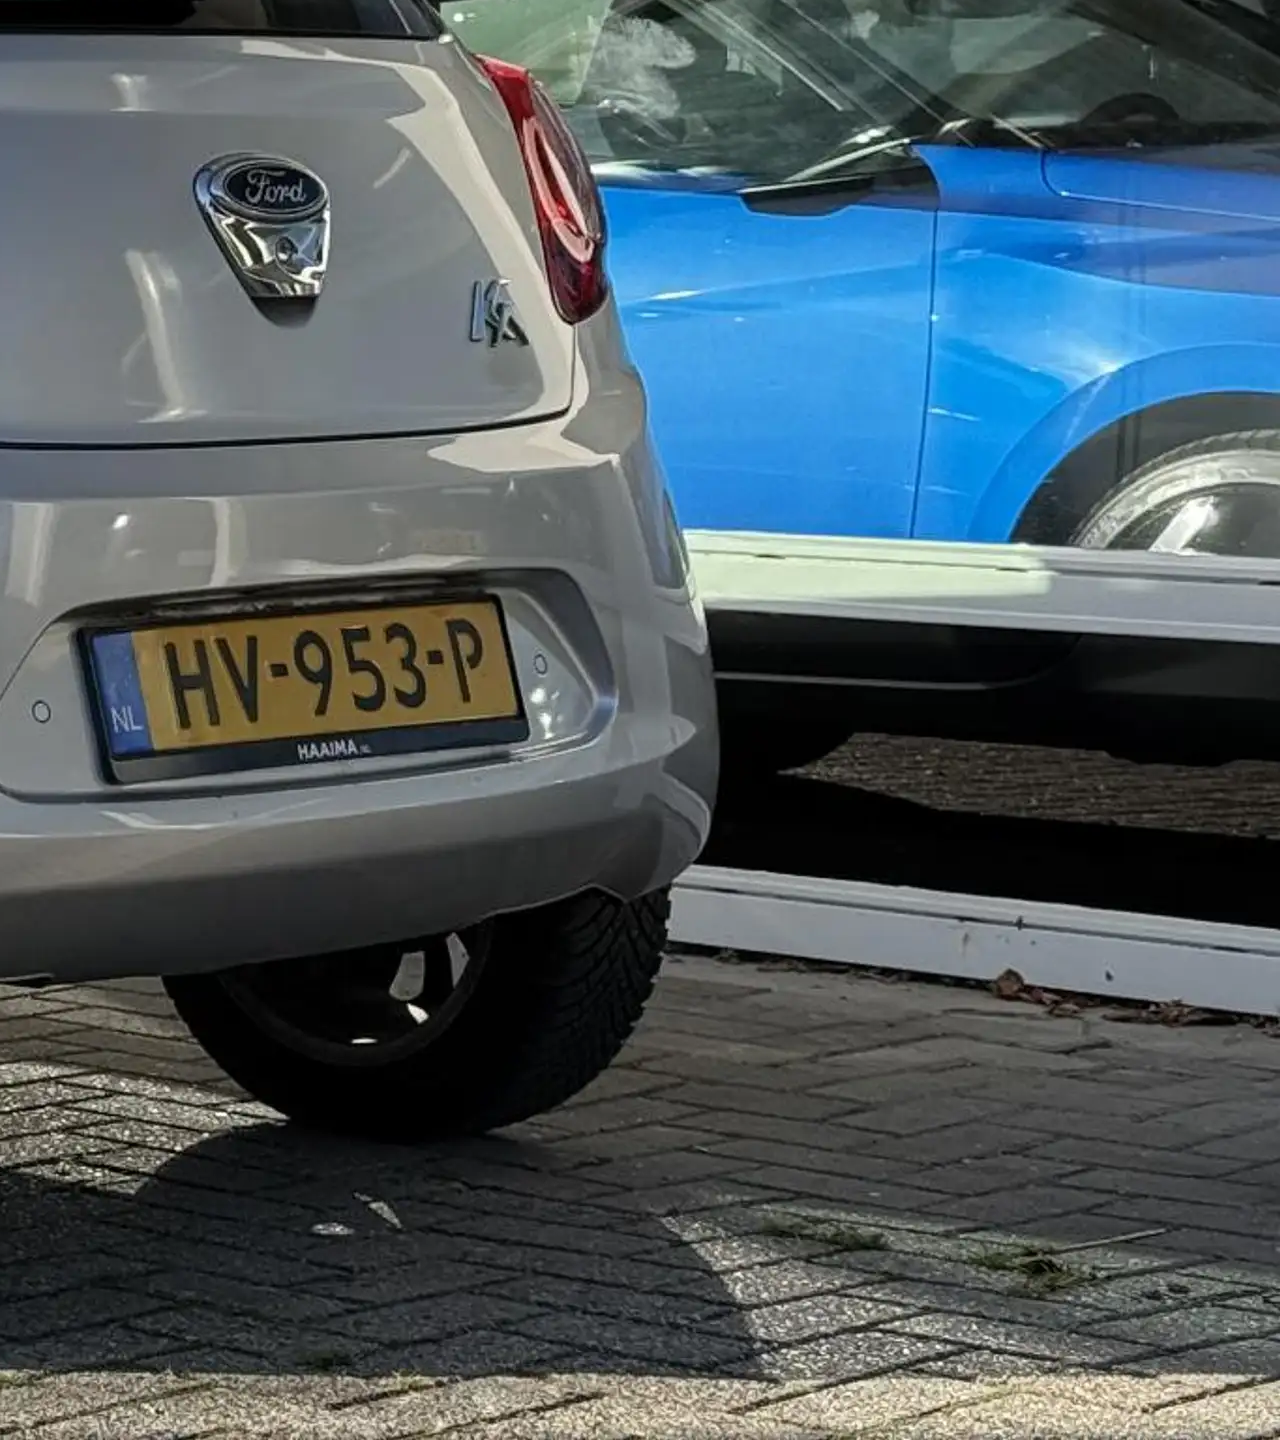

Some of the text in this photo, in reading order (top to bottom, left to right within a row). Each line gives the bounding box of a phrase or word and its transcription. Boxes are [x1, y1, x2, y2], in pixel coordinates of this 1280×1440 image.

[244, 168, 308, 203] Ford
[163, 618, 484, 730] HV-953-P
[110, 705, 144, 733] NL
